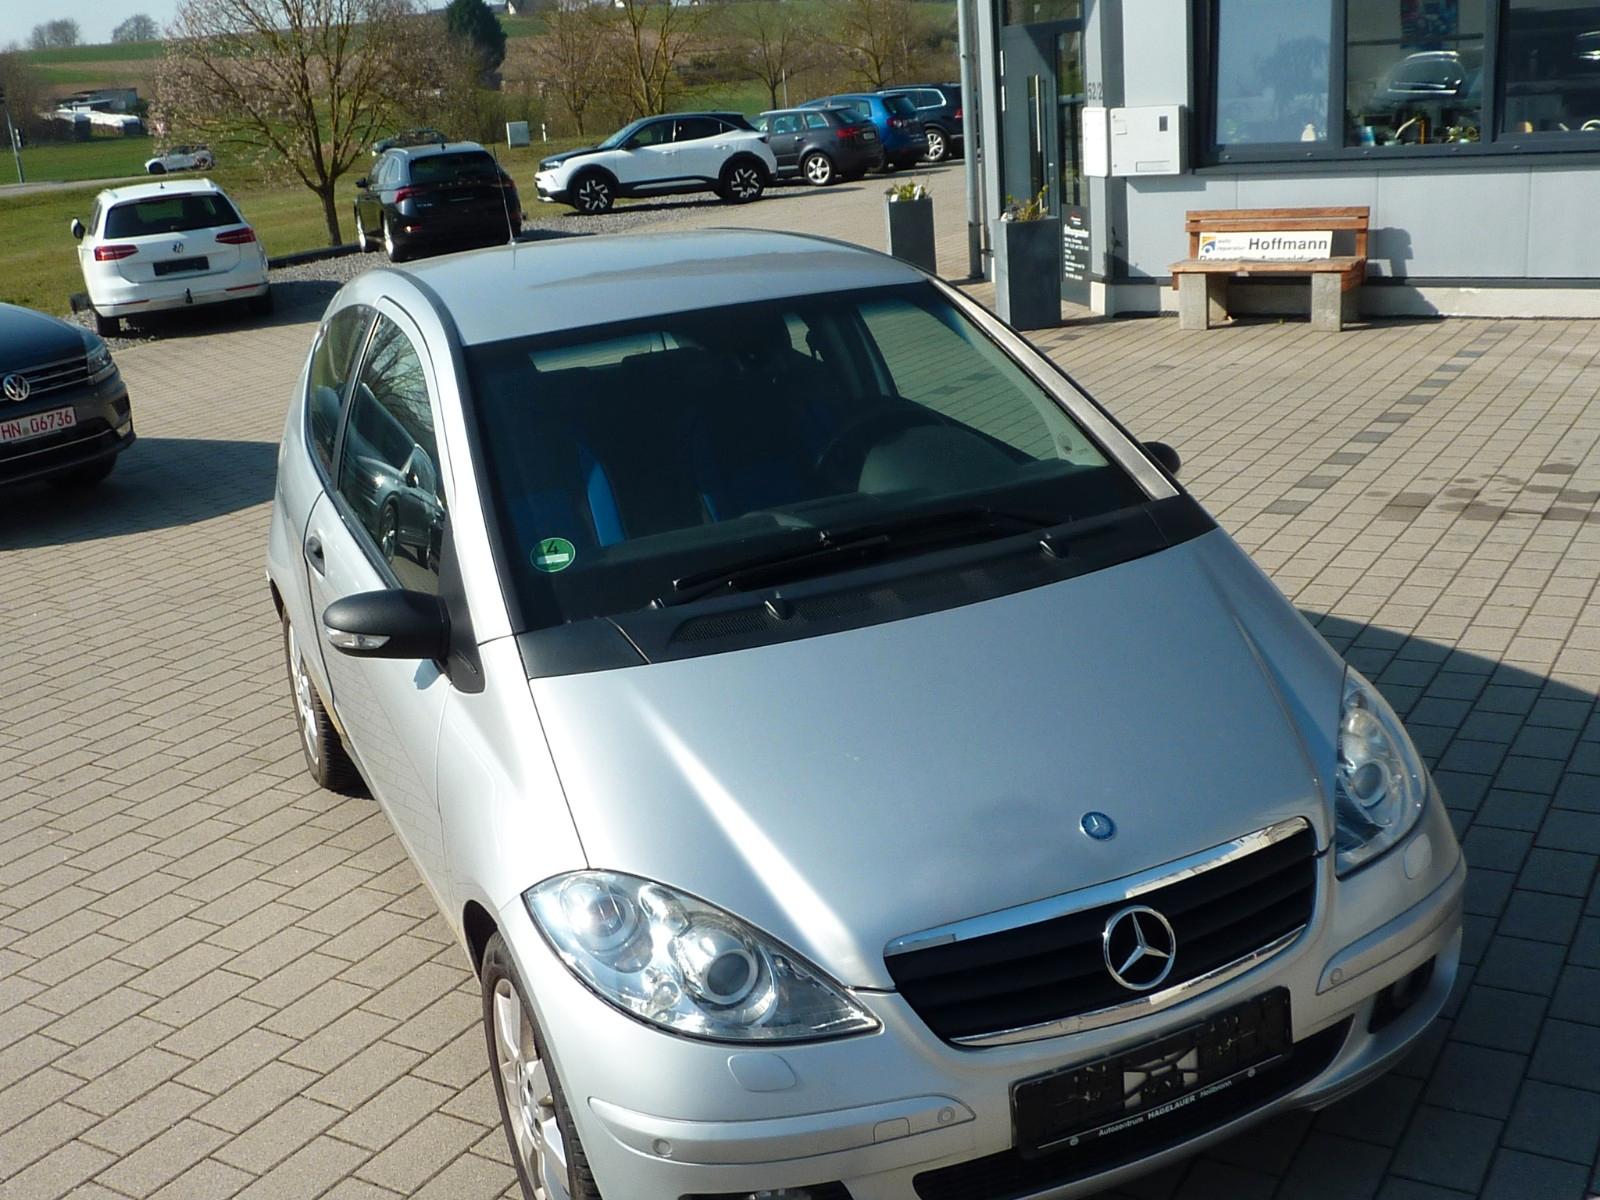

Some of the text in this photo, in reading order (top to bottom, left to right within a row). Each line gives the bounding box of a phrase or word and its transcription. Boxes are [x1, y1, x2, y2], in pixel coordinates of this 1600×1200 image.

[1248, 238, 1328, 250] Hoffmann
[1, 410, 72, 440] HN 06736
[546, 540, 558, 554] 4
[1099, 1117, 1144, 1136] Autozentrum
[1147, 1095, 1195, 1119] HAGELAUER
